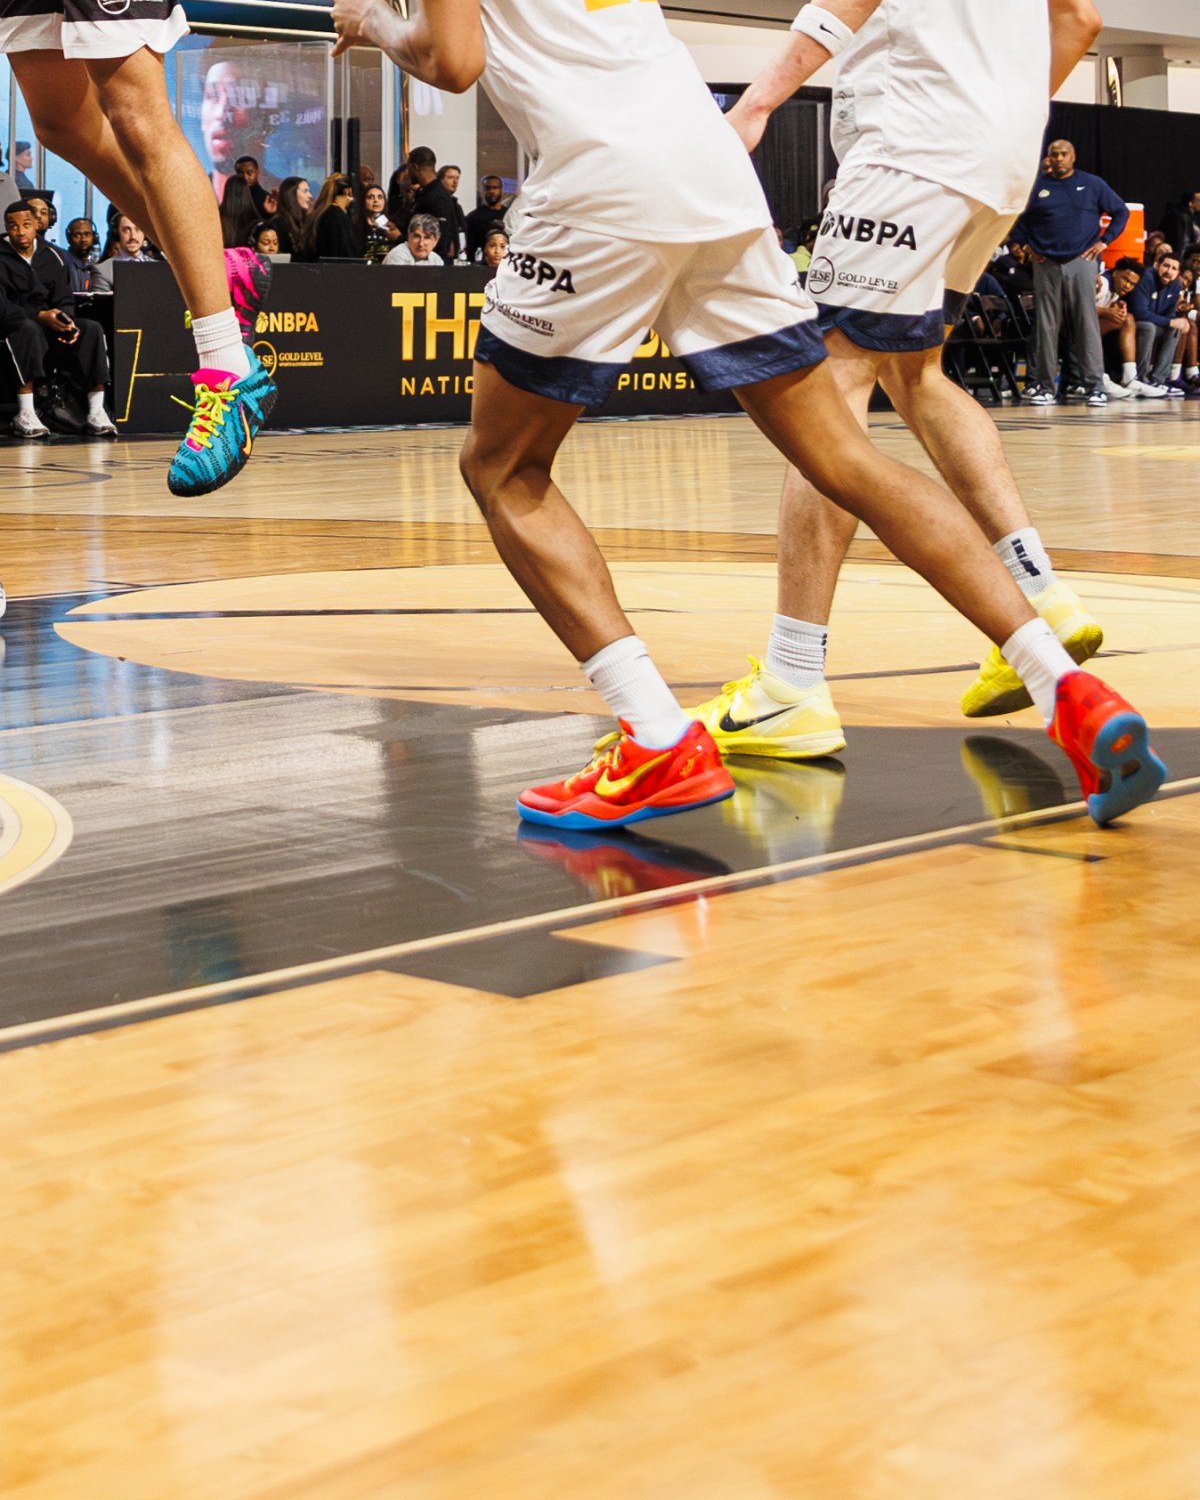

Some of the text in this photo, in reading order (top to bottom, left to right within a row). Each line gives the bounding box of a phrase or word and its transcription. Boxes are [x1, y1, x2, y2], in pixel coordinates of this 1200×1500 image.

[832, 214, 917, 251] NBPA
[503, 250, 576, 294] NBPA
[838, 271, 898, 289] GOLD LEVEL
[269, 312, 319, 332] NBPA
[521, 314, 555, 332] LEVEL
[279, 352, 323, 361] GOLD LEVEL
[401, 376, 474, 395] NATIO
[618, 372, 694, 390] PIONS
